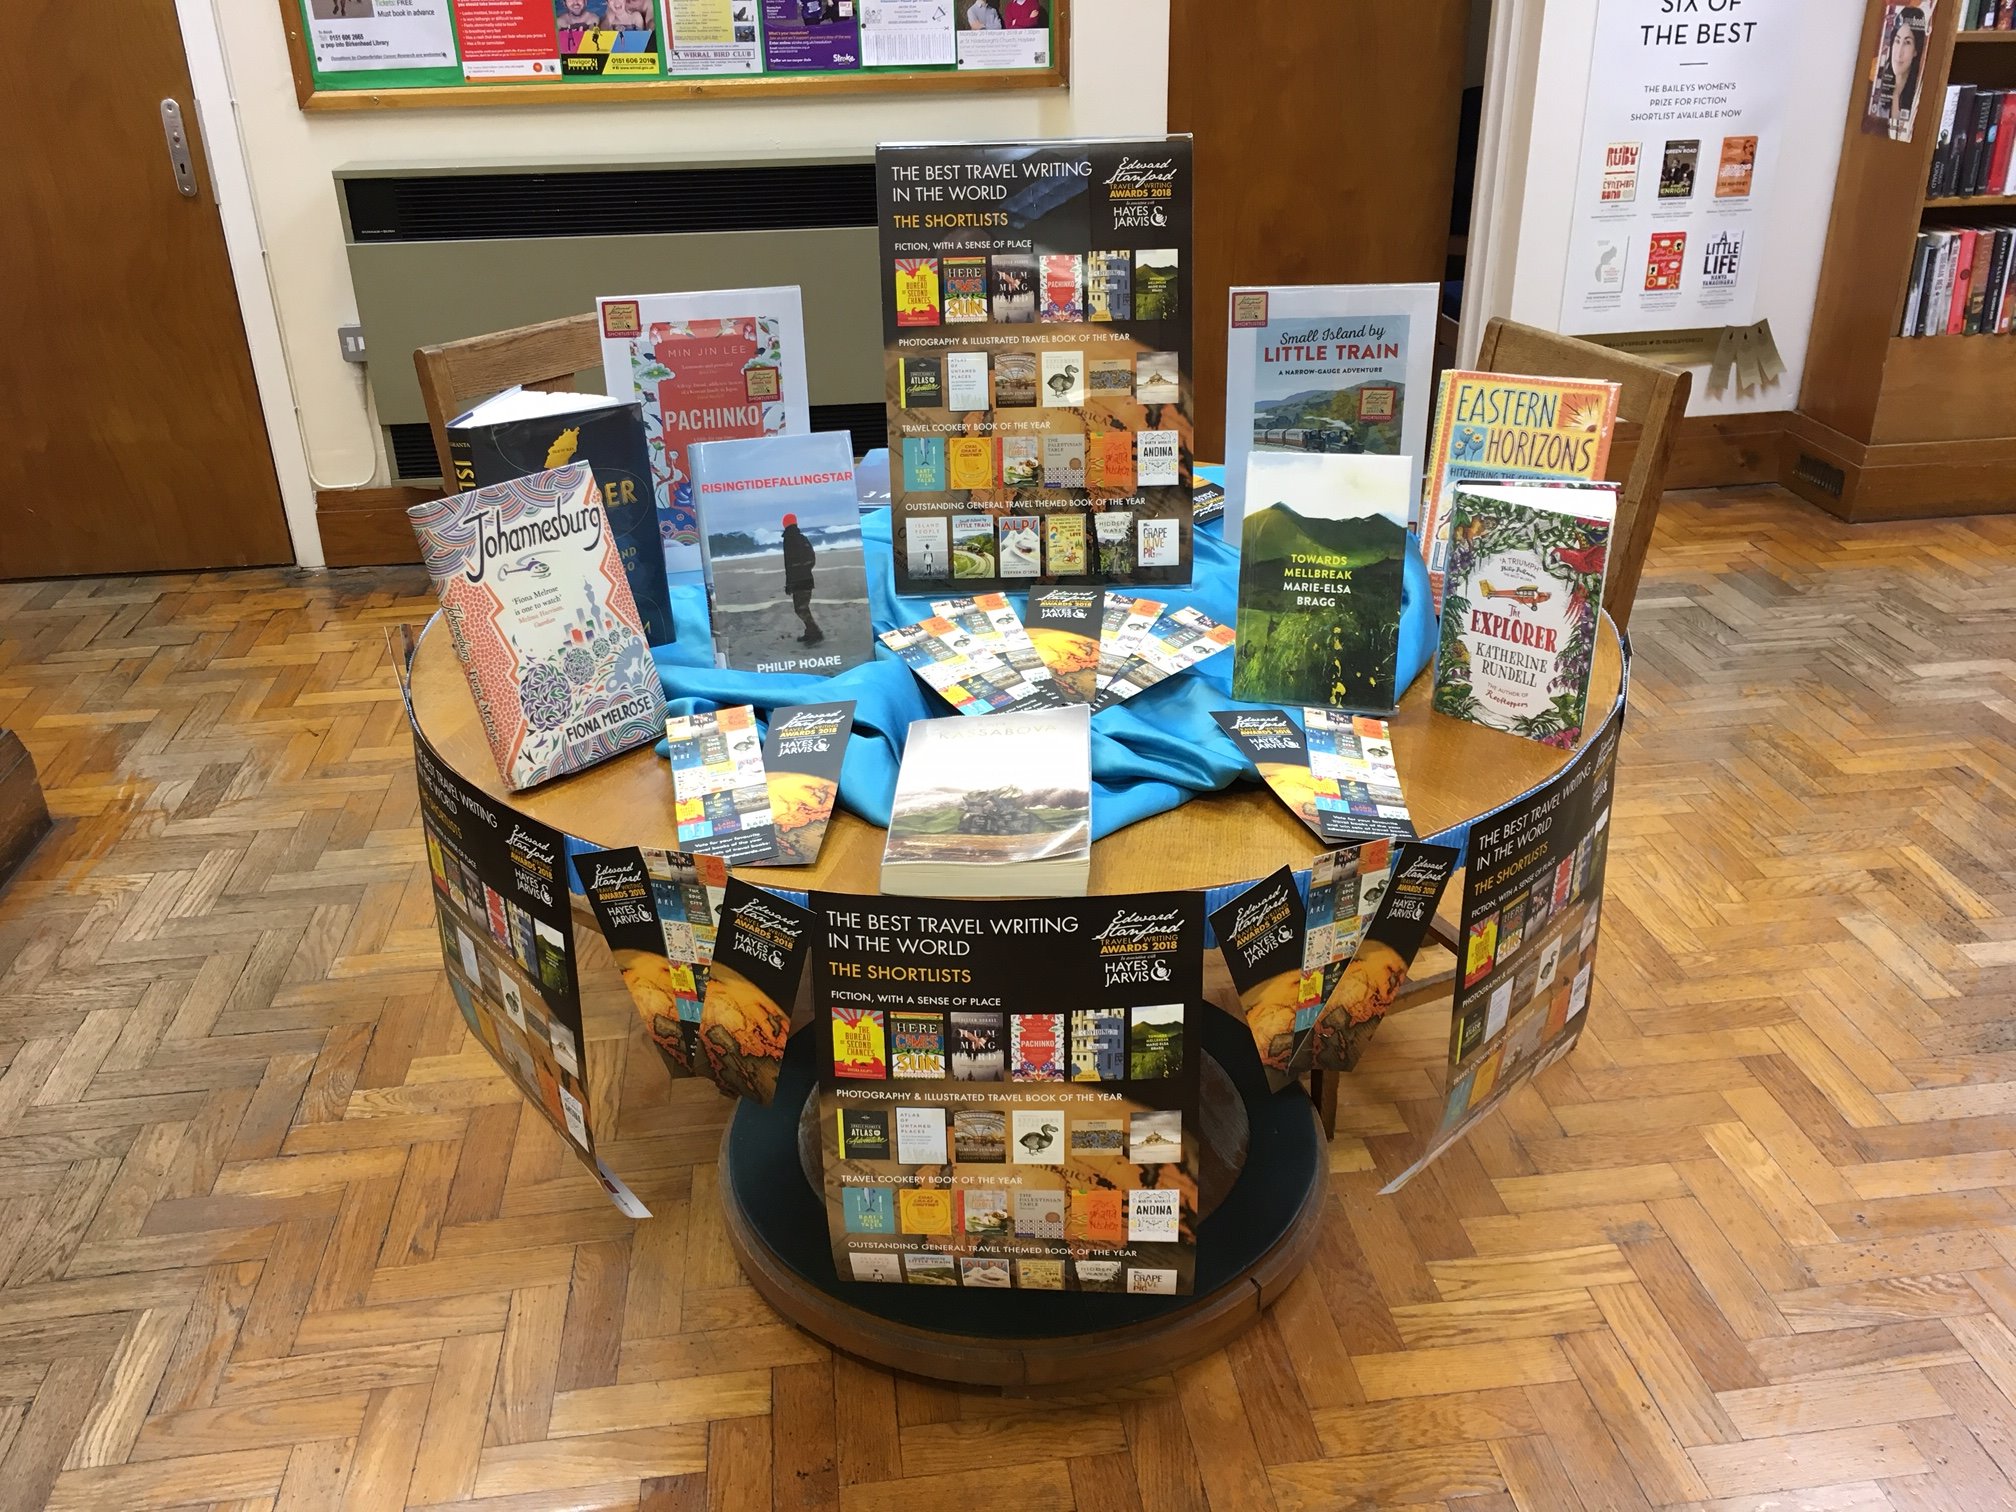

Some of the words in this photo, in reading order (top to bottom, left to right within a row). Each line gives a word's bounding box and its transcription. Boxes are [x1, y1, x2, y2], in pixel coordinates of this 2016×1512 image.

[413, 9, 435, 17] advance
[1661, 0, 1698, 13] SIX
[1640, 24, 1689, 46] THE
[1696, 22, 1757, 45] BEST
[1644, 85, 1660, 93] THE
[1662, 84, 1695, 93] BAILEYS
[1698, 82, 1736, 91] WOMEN'S
[1650, 99, 1672, 107] PRIZE
[1675, 98, 1692, 106] FOR
[1693, 97, 1727, 105] FICTION
[1630, 112, 1675, 121] SHORTLIST
[1677, 111, 1719, 120] AVAILABLE
[1721, 110, 1742, 118] NOW
[1118, 156, 1173, 170] Edward
[891, 166, 920, 181] THE
[925, 165, 960, 180] BEST
[965, 164, 1018, 179] TRAVEL
[1022, 161, 1093, 178] WRITING
[1102, 168, 1177, 188] Stanford
[892, 187, 910, 202] IN
[915, 186, 943, 201] THE
[948, 185, 1007, 200] WORLD
[1109, 189, 1149, 198] AWARDS
[1151, 188, 1172, 197] 2018
[1113, 205, 1149, 217] HAYES
[893, 215, 920, 229] THE
[924, 213, 1008, 228] SHORTLISTS
[1113, 216, 1150, 230] JARVIS
[894, 242, 931, 251] FICTION,
[932, 241, 955, 250] WITH
[956, 241, 963, 249] A
[965, 241, 990, 249] SENSE
[993, 240, 1005, 249] OF
[1007, 239, 1032, 248] PLACE
[1719, 231, 1728, 244] A
[1706, 242, 1740, 256] LITTLE
[948, 267, 982, 278] HERE
[1703, 255, 1738, 275] LIFE
[898, 337, 960, 347] PHOTOGRAPHY
[962, 337, 968, 346] &
[971, 336, 1020, 345] ILLUSTRATED
[1022, 335, 1050, 344] TRAVEL
[1052, 335, 1077, 343] BOOK
[1079, 334, 1091, 342] OF
[1093, 334, 1107, 342] THE
[1109, 333, 1130, 341] YEAR
[1280, 329, 1319, 346] Small
[1322, 325, 1366, 342] Island
[1368, 324, 1386, 340] by
[668, 349, 691, 358] MIN
[698, 347, 717, 357] JIN
[723, 345, 746, 355] LEE
[1264, 345, 1327, 362] LITTLE
[1335, 343, 1399, 361] TRAIN
[1285, 368, 1340, 376] NARROW-GAUGE
[1455, 385, 1558, 428] EASTERN
[664, 405, 760, 432] PACHINKO
[902, 424, 930, 432] TRAVEL
[932, 423, 972, 432] COOKERY
[974, 423, 998, 431] BOOK
[1000, 422, 1012, 430] OF
[1014, 422, 1029, 430] THE
[1030, 421, 1051, 429] YEAR
[1143, 446, 1173, 458] ANDINA
[1485, 428, 1596, 473] HORIZONS
[1450, 466, 1498, 480] HITCHHIKING
[701, 471, 853, 494] RISINGTIDEFALLINGSTAR
[905, 502, 965, 511] OUTSTANDING
[967, 501, 1003, 510] GENERAL
[1006, 500, 1033, 509] TRAVEL
[1035, 499, 1067, 508] THEMED
[1069, 499, 1094, 507] BOOK
[1096, 498, 1107, 506] OF
[1109, 498, 1124, 506] THE
[1126, 497, 1146, 506] YEAR
[1002, 520, 1038, 531] ALPS
[463, 496, 601, 583] Johannesburg
[1290, 553, 1348, 567] TOWARDS
[1283, 566, 1353, 581] MELLBREAK
[533, 585, 559, 600] Melrose
[1283, 581, 1352, 596] MARIE-ELSA
[1296, 595, 1336, 608] BRAGG
[514, 608, 521, 616] is
[522, 606, 534, 615] one
[534, 603, 542, 612] to
[1508, 604, 1520, 618] The
[441, 600, 471, 663] Johannesburg
[1470, 609, 1557, 653] EXPLORER
[757, 660, 796, 673] PHILIP
[799, 655, 842, 669] HOARE
[1475, 641, 1548, 674] KATHERINE
[1481, 659, 1537, 688] RUNDELL
[469, 668, 484, 703] Fiona
[481, 702, 499, 746] Melrose
[565, 715, 601, 743] FIONA
[601, 695, 652, 728] MELROSE
[459, 790, 499, 828] WRITING
[1478, 828, 1501, 850] THE
[1503, 816, 1528, 840] BEST
[1530, 795, 1561, 822] TRAVEL
[1562, 762, 1591, 800] WRITING
[1476, 852, 1491, 872] IN
[1494, 839, 1514, 864] THE
[1517, 816, 1553, 849] WORLD
[1474, 878, 1496, 896] THE
[1496, 841, 1549, 885] SHORTLISTS
[606, 905, 636, 918] HAYES
[1112, 909, 1179, 924] Edward
[611, 915, 639, 928] JARVIS
[826, 910, 861, 929] THE
[868, 914, 911, 931] BEST
[917, 917, 984, 934] TRAVEL
[990, 916, 1079, 934] WRITING
[1091, 919, 1185, 943] Stanford
[828, 933, 849, 949] IN
[855, 935, 890, 952] THE
[896, 938, 970, 956] WORLD
[1100, 943, 1149, 954] AWARDS
[1152, 941, 1178, 951] 2018
[829, 961, 861, 978] THE
[867, 965, 971, 983] SHORTLISTS
[1105, 960, 1148, 973] HAYES
[1104, 970, 1149, 987] JARVIS
[896, 1023, 938, 1034] HERE
[1020, 1040, 1055, 1048] PACHINKO
